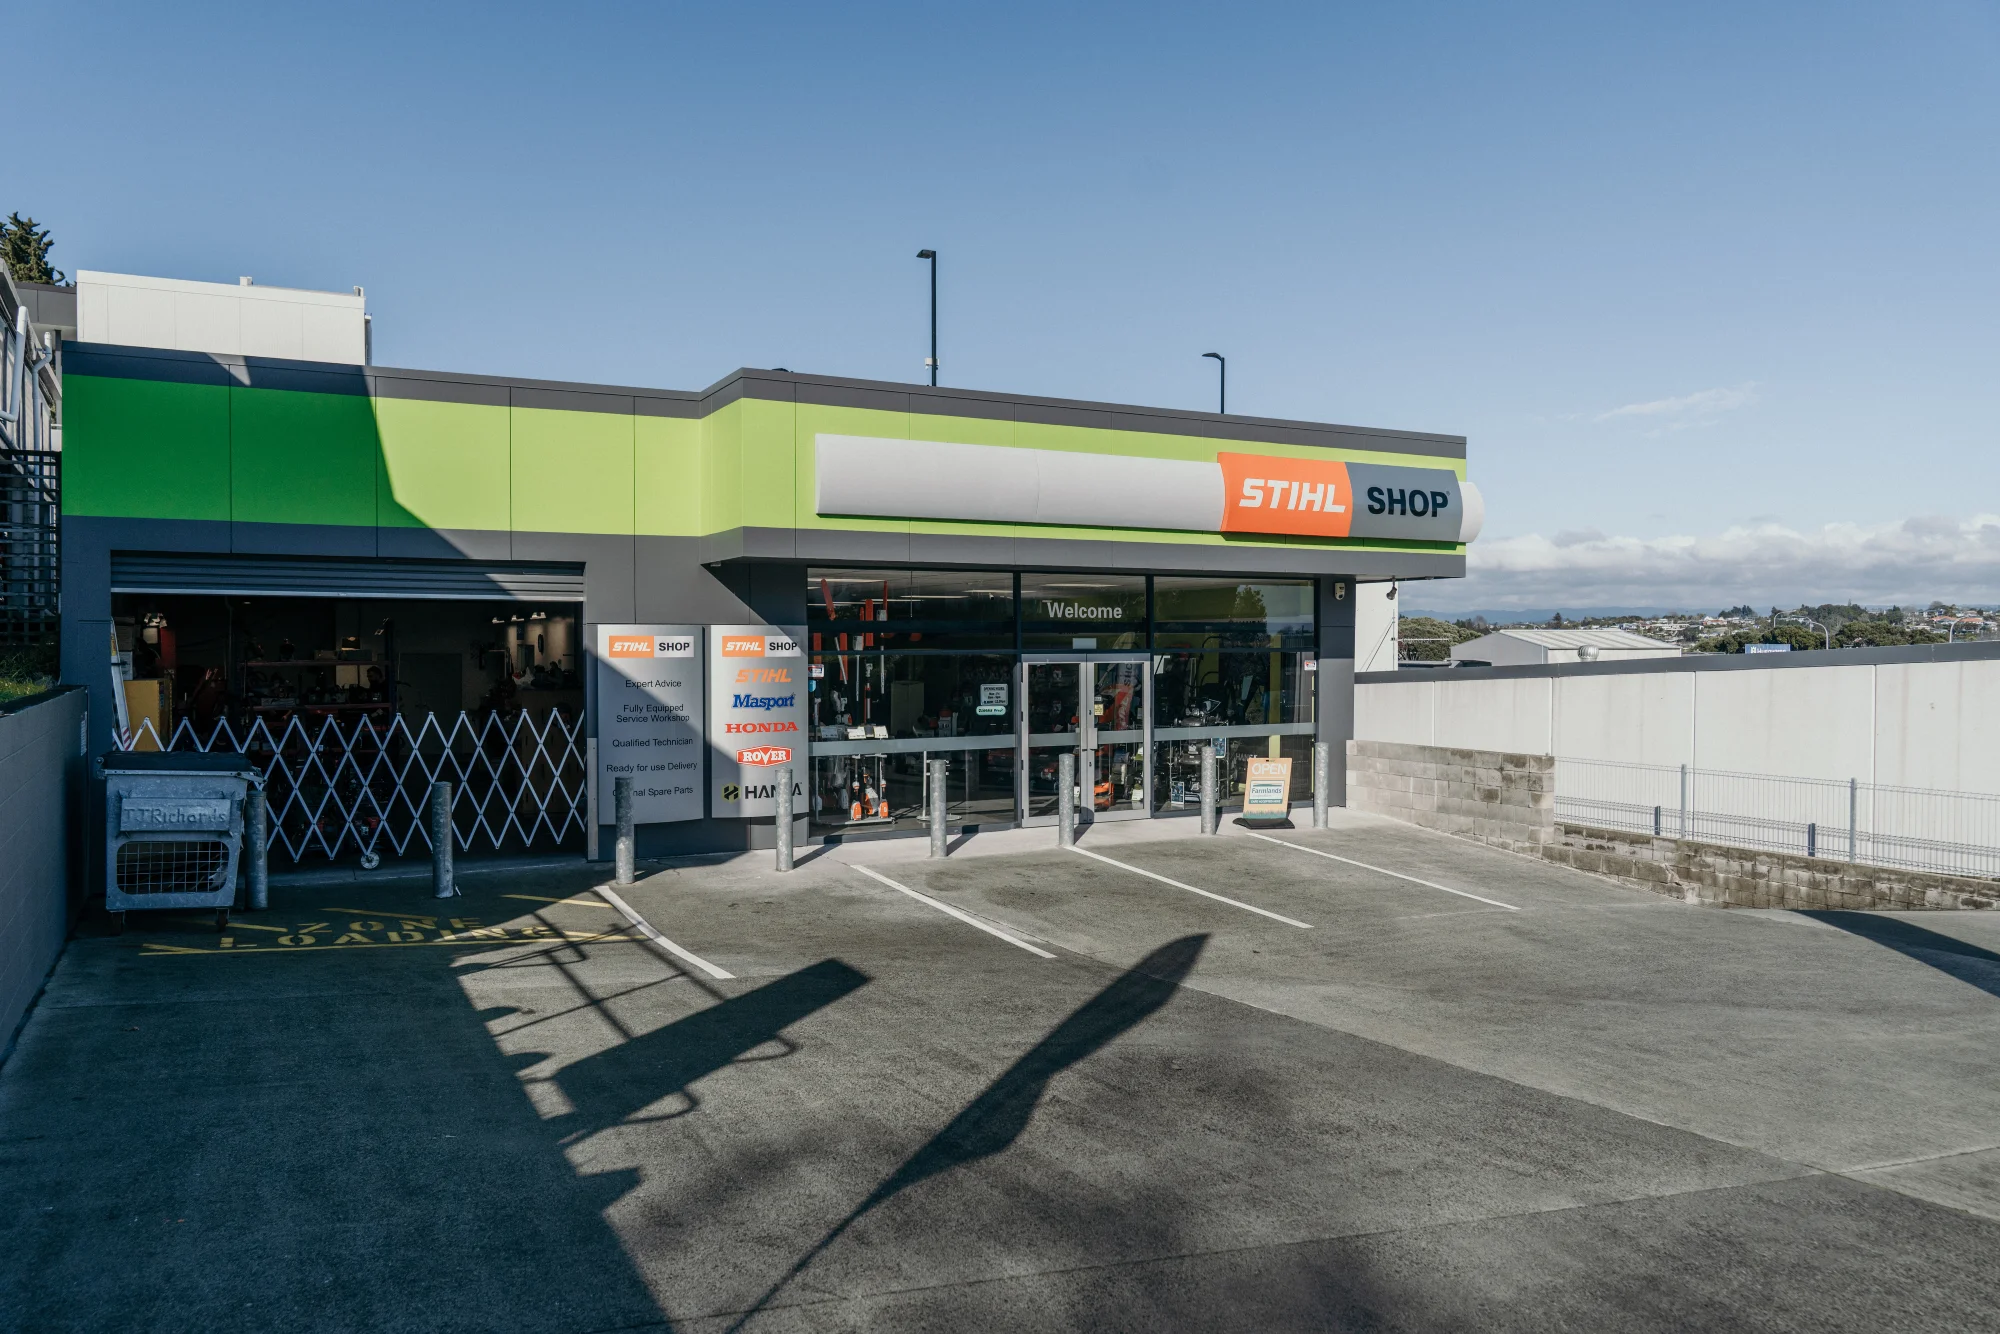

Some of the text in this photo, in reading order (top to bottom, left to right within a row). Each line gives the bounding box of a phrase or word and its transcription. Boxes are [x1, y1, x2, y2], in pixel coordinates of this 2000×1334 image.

[1239, 477, 1449, 518] STIHL SHOP
[1046, 602, 1123, 619] Welcome
[612, 641, 690, 652] STIHL SHOP
[725, 641, 798, 651] STIHL SHOP
[735, 668, 792, 683] STIHL
[625, 680, 682, 689] Expert Advice
[732, 693, 795, 711] Masport
[623, 704, 684, 714] Fully Equipped
[616, 713, 690, 723] Service Workshop
[725, 721, 799, 734] HONDA
[612, 738, 693, 747] Qualified Technician
[742, 747, 787, 765] ROVER
[606, 764, 634, 773] Ready
[636, 764, 648, 772] for
[668, 762, 698, 771] Delivery
[1251, 763, 1287, 775] OPEN
[647, 788, 672, 797] Spare
[674, 787, 694, 795] Parts
[744, 782, 802, 799] HAA
[297, 917, 486, 933] ZONE
[219, 926, 552, 948] LOADING
